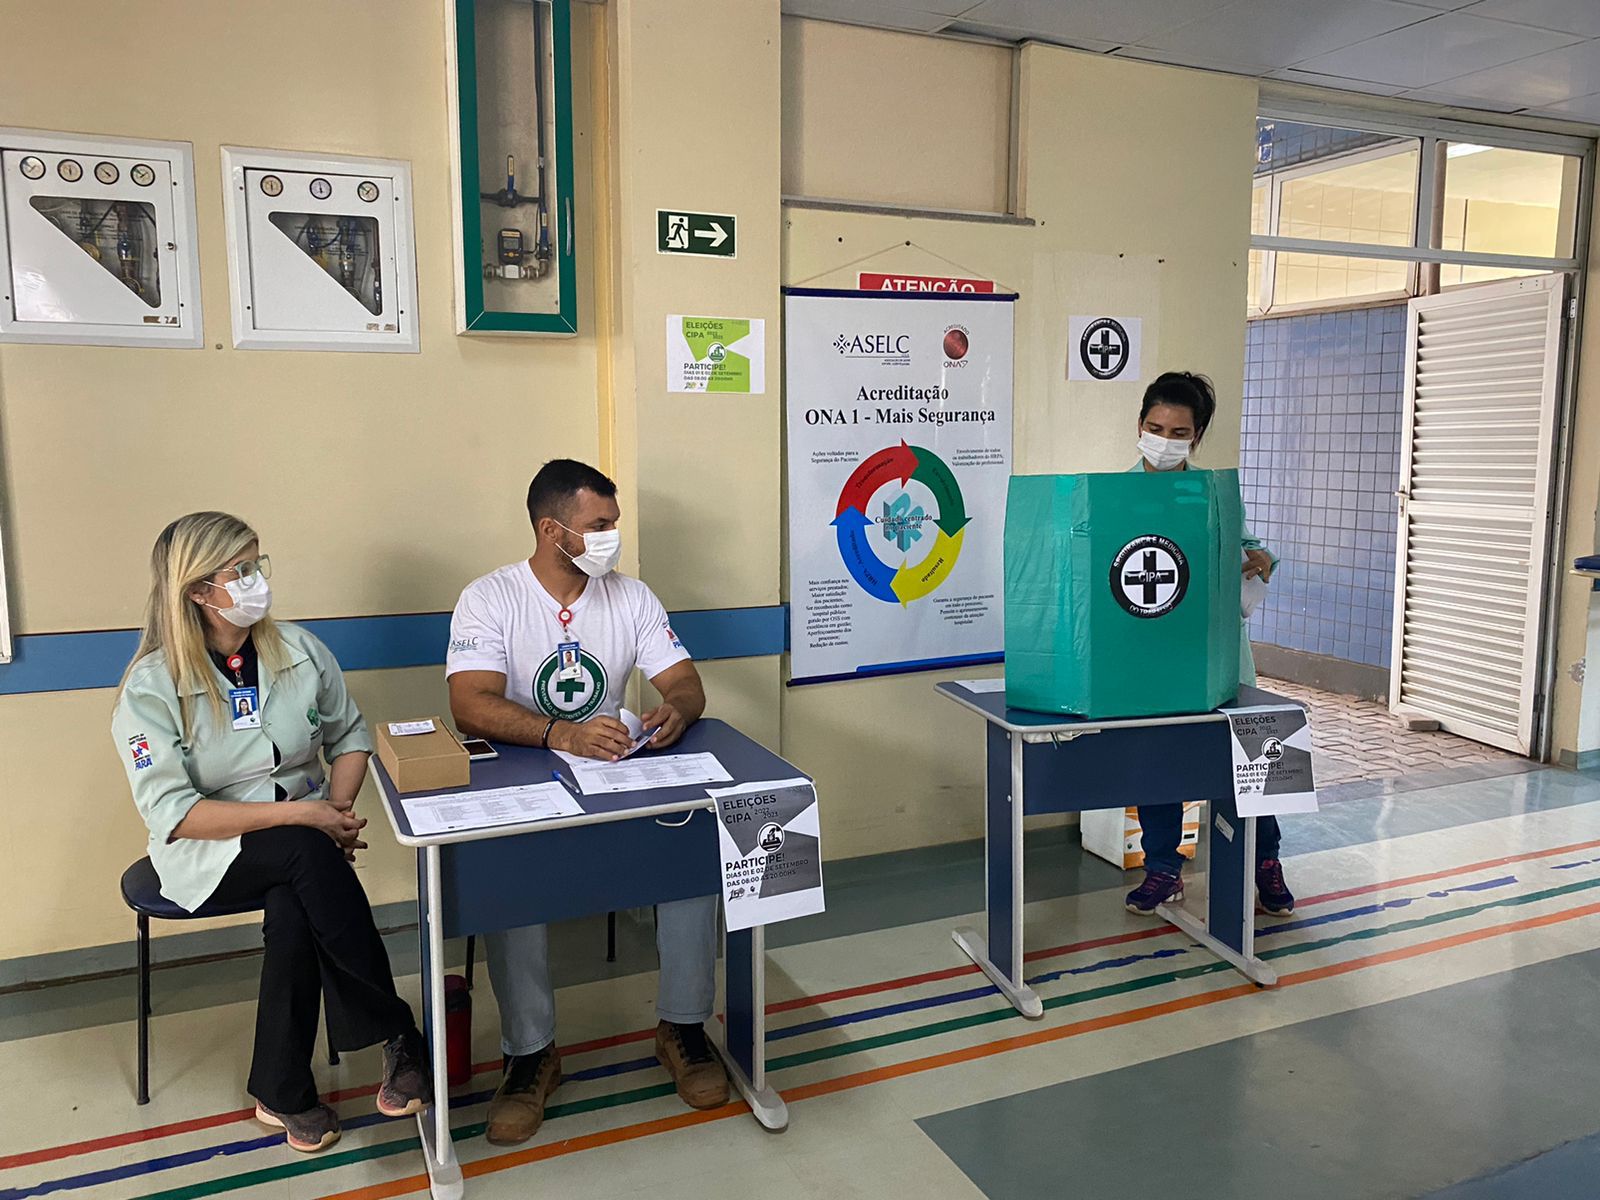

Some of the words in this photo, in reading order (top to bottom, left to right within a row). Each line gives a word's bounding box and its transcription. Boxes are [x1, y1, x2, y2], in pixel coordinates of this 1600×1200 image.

[686, 321, 723, 330] ELEIÇÕES
[850, 335, 910, 354] ASELC
[857, 385, 948, 403] Acreditação
[805, 409, 847, 425] ONA
[852, 409, 859, 424] 1
[876, 408, 913, 424] Mais
[918, 408, 995, 427] Segurança
[1158, 537, 1184, 566] MEDICINA
[921, 557, 944, 583] Resultado
[1138, 571, 1162, 582] CIPA
[541, 680, 553, 710] PREVENÇÃO
[588, 681, 601, 706] TRABALHO
[1235, 715, 1276, 725] ELEIÇÕES
[1236, 728, 1258, 736] CIPA
[1236, 761, 1284, 772] PARTICIPE!
[723, 794, 776, 810] ELEIÇÕES
[725, 812, 752, 824] CIPA
[754, 807, 770, 815] 2022
[725, 853, 785, 871] PARTICIPE!
[775, 859, 809, 870] SETEMBRO
